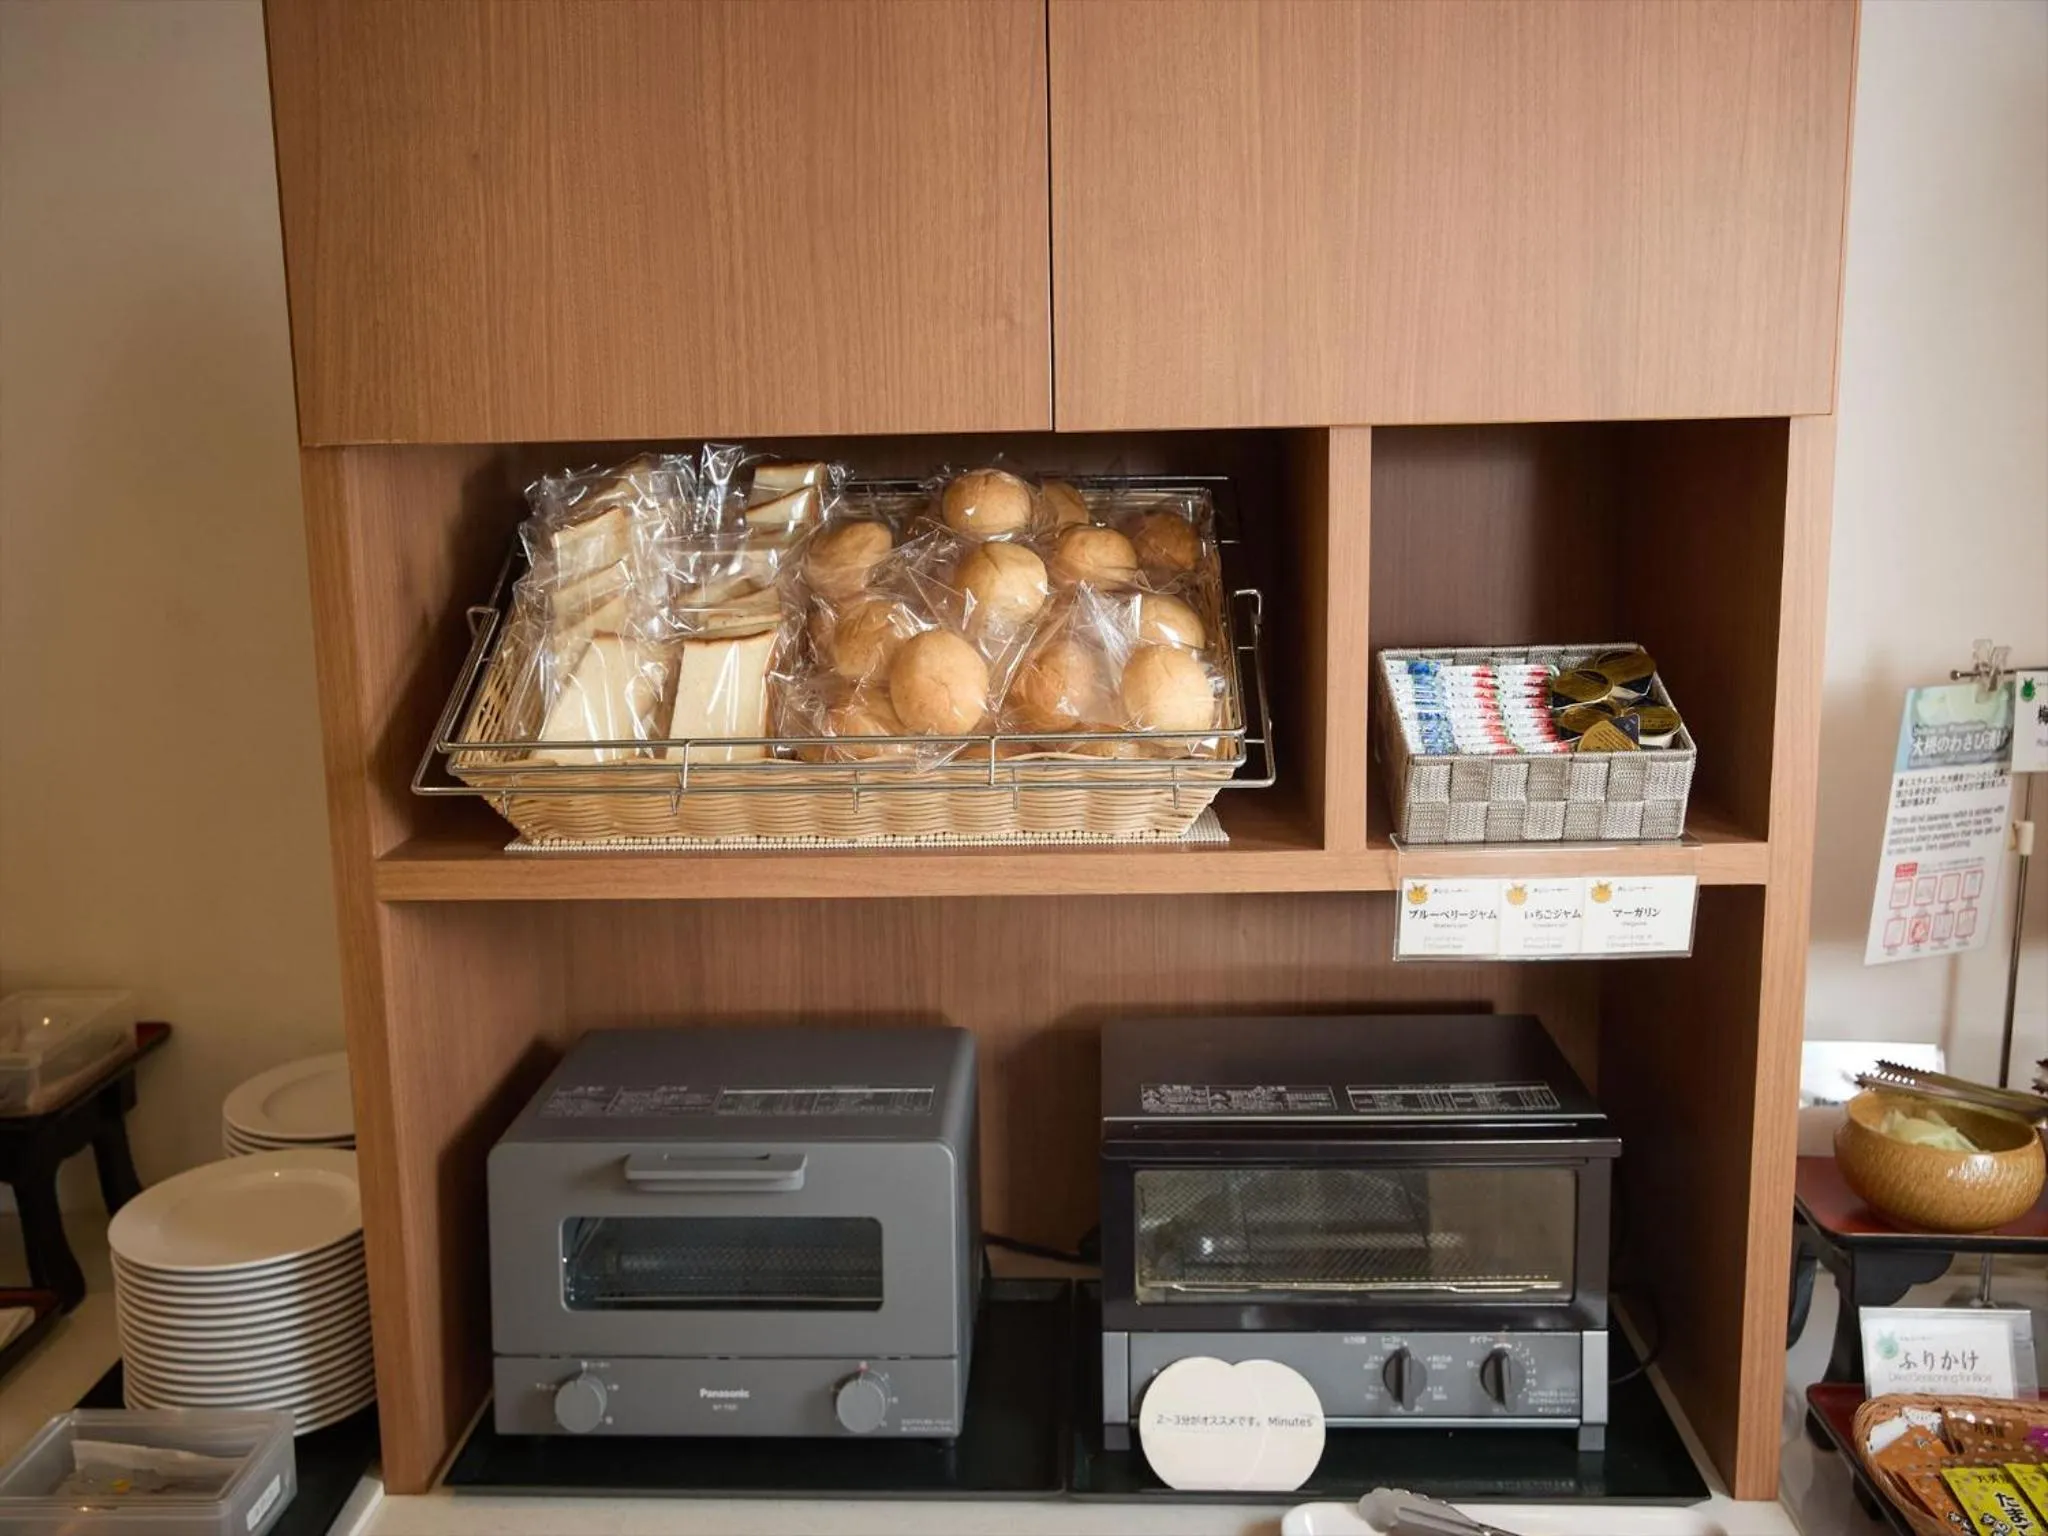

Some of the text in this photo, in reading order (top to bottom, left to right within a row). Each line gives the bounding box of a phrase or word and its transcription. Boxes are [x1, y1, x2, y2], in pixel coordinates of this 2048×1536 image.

[1408, 909, 1498, 921] ブルーベリージャム
[1524, 908, 1582, 920] いちごジャム
[1612, 907, 1662, 918] マーガリン
[1898, 1349, 1980, 1371] ふりかけ
[699, 1387, 750, 1398] Panasonic
[1268, 1415, 1313, 1427] Minutes
